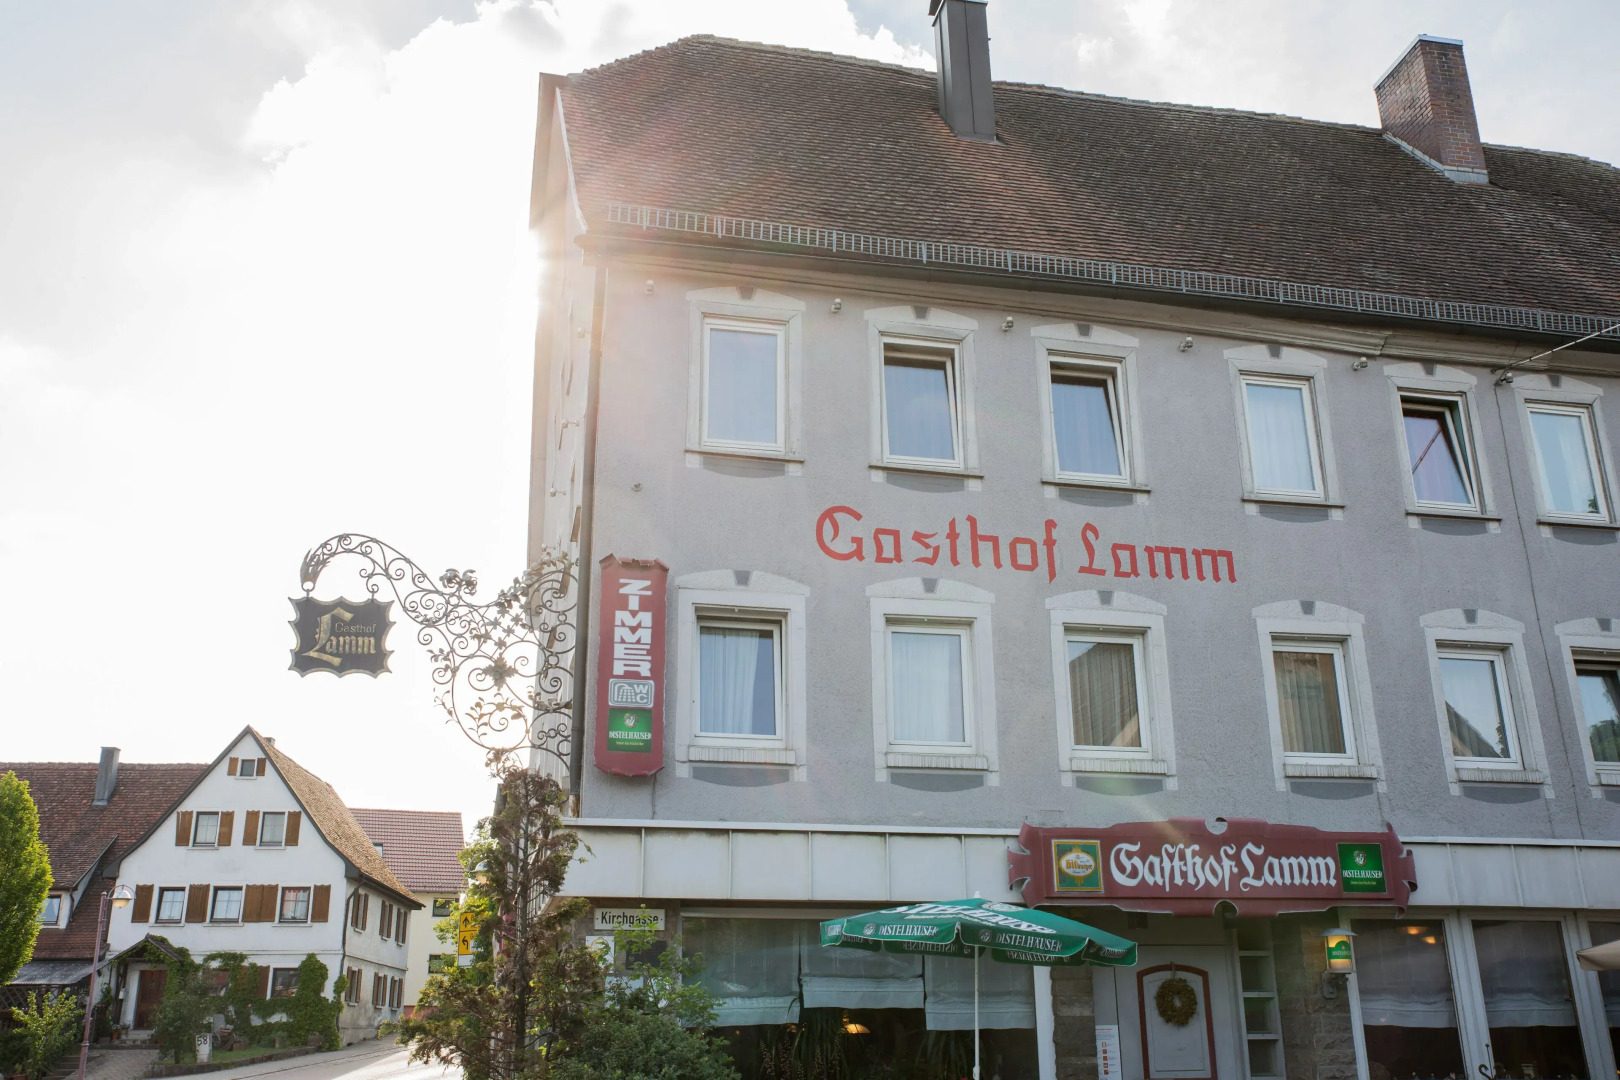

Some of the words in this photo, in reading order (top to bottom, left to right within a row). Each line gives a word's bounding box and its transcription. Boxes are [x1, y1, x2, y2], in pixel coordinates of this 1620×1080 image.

[815, 505, 1057, 584] Gasthof
[1077, 522, 1237, 583] Lamm
[301, 607, 376, 666] Lamm
[335, 622, 376, 633] Gasthof
[613, 579, 653, 677] ZIMMER
[1240, 842, 1337, 892] Lamm
[996, 932, 1063, 952] DISTELHÄUSER
[197, 1035, 208, 1046] 58
